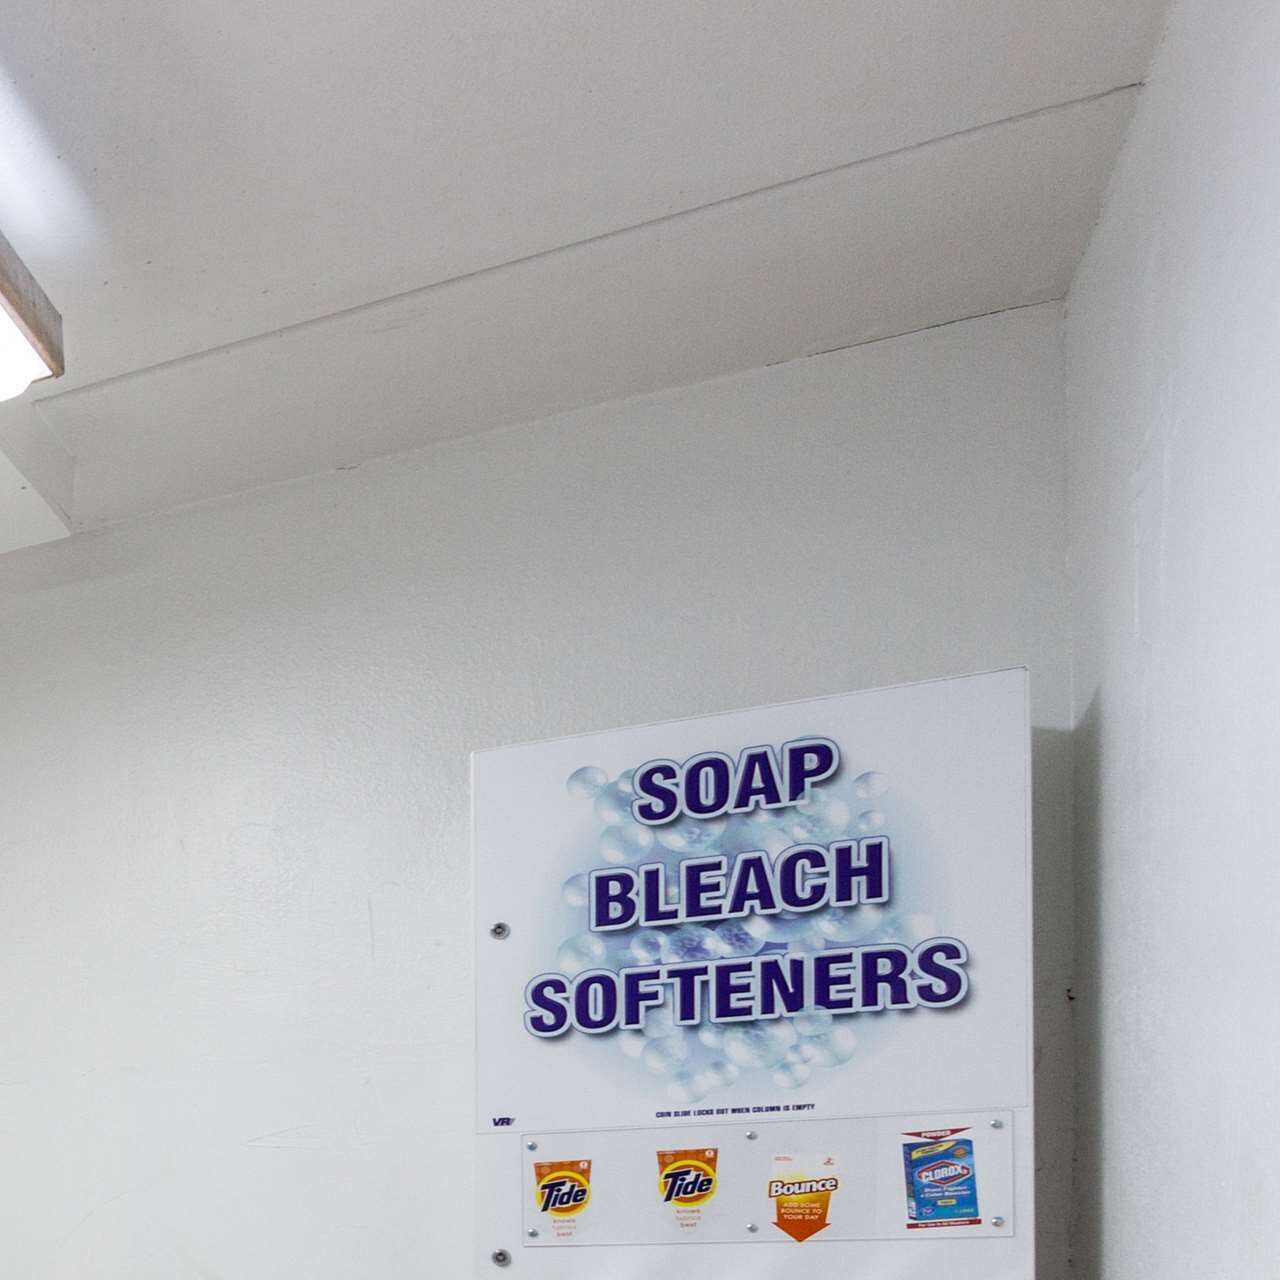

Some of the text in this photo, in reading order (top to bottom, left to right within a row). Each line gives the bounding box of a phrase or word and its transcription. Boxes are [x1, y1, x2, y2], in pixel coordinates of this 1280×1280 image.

[635, 739, 837, 823] SOAP
[592, 838, 886, 930] BLEACH
[528, 940, 965, 1034] SOFTENERS
[792, 1103, 815, 1111] EMPTY
[663, 1168, 713, 1202] Tide
[769, 1178, 838, 1198] Bounce
[922, 1165, 962, 1182] CLOROX
[540, 1180, 587, 1212] Tide
